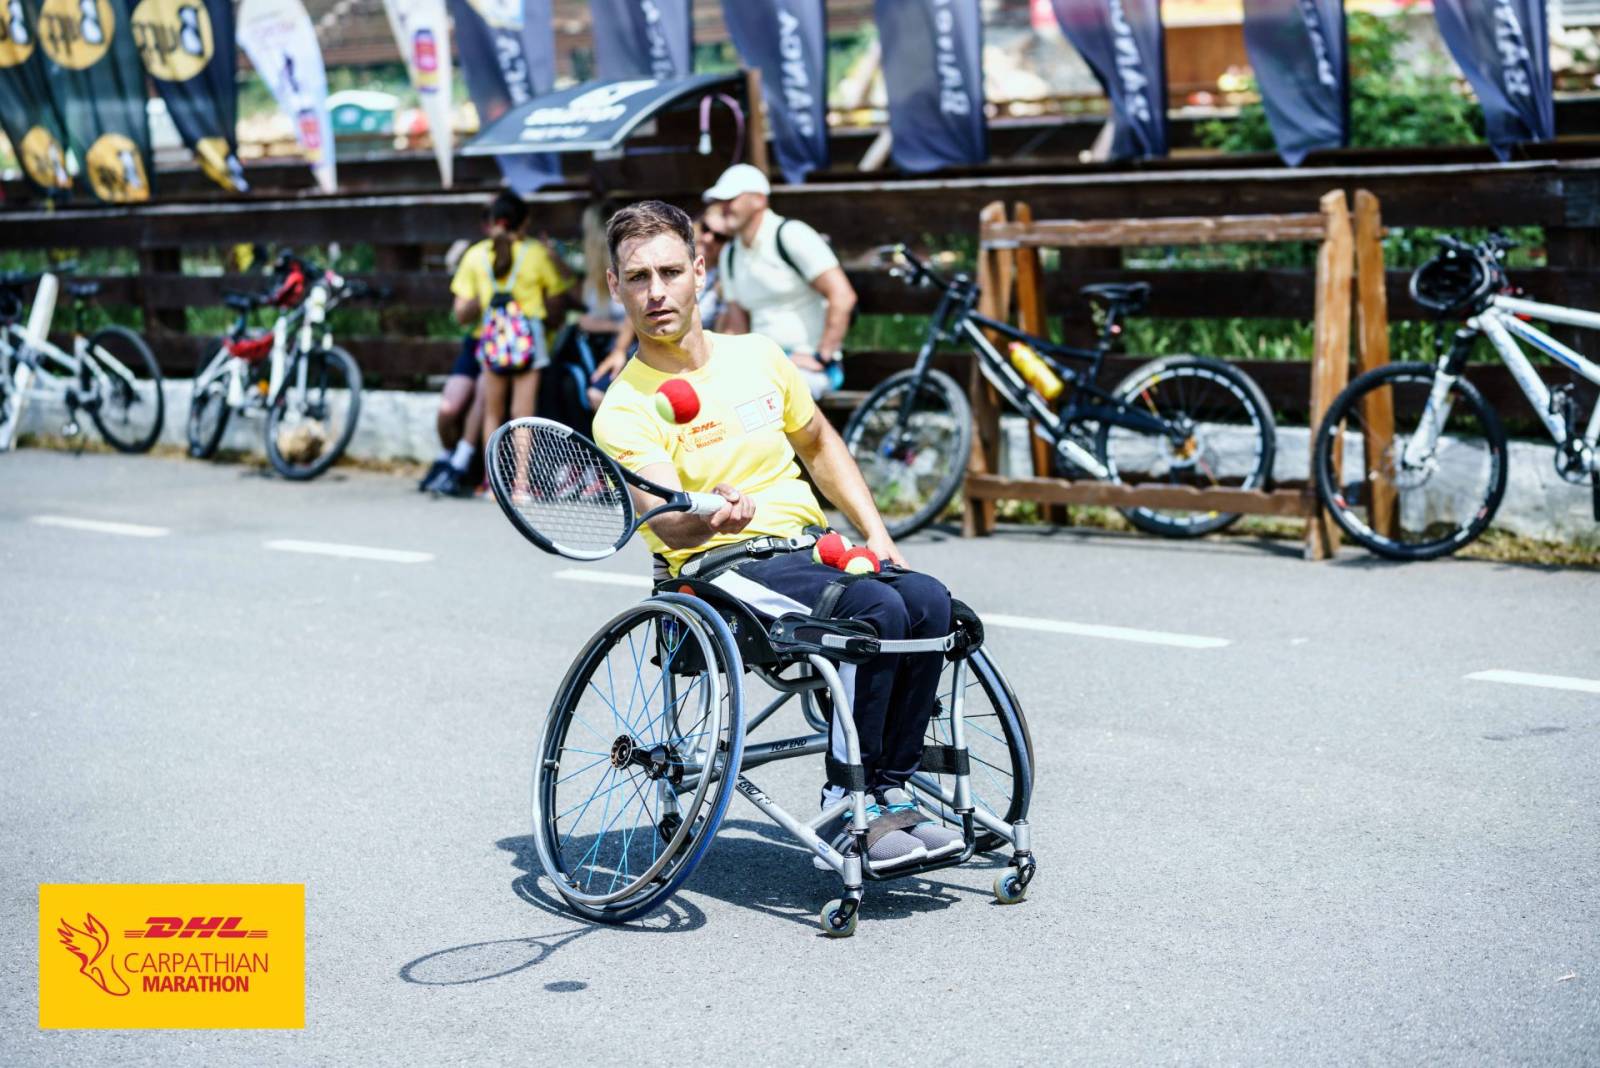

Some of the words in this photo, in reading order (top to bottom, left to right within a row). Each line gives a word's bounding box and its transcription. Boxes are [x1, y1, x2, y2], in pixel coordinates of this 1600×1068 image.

[691, 421, 718, 435] DHL
[769, 740, 788, 752] TOP
[789, 737, 808, 748] END
